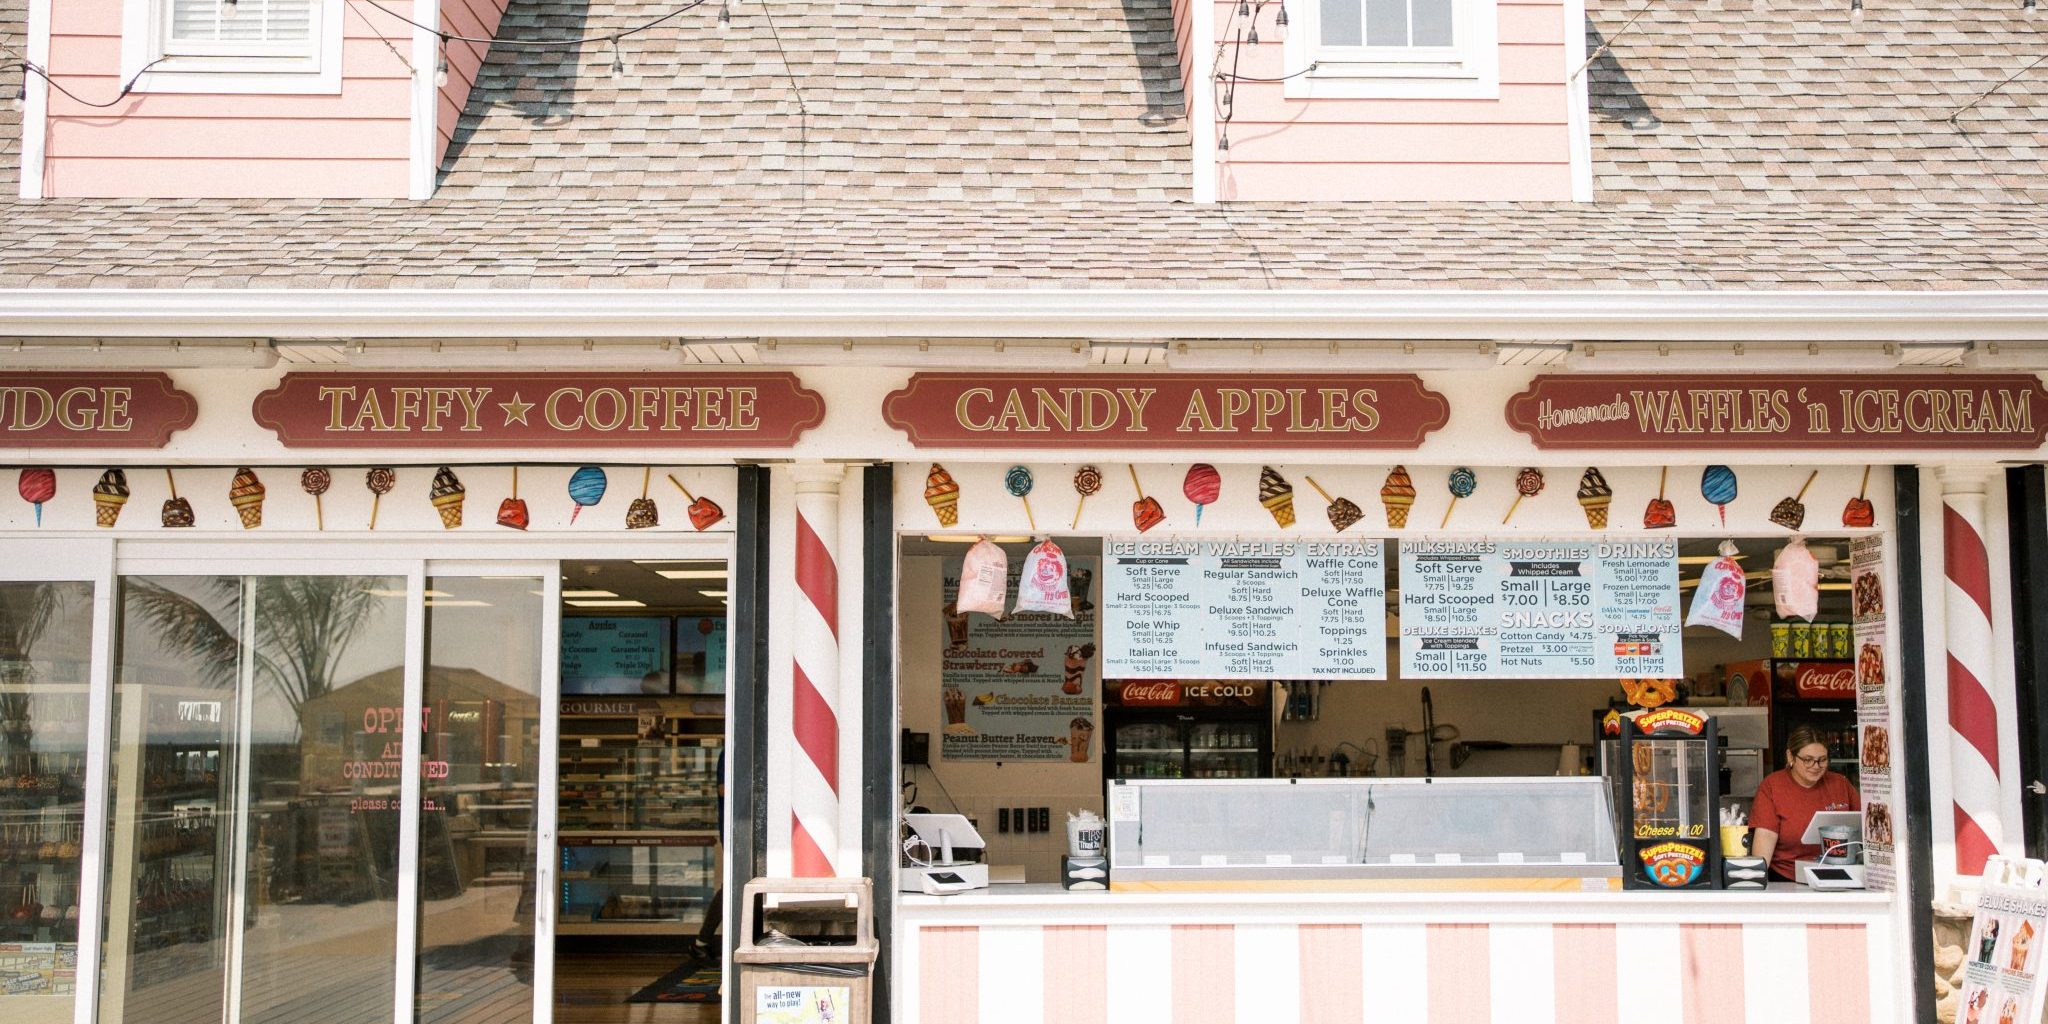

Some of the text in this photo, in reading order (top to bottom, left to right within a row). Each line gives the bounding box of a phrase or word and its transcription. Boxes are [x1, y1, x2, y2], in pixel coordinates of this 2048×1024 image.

[320, 386, 760, 432] TAFFY COFFEE
[955, 387, 1380, 433] CANDY APPLES
[1539, 394, 1630, 430] Homemade
[1631, 388, 1789, 434] WAFFLES
[1840, 389, 1900, 433] ICE
[1905, 389, 2034, 434] CREAM
[1108, 542, 1200, 556] ICE CREAM
[1207, 542, 1295, 556] WAFFLES
[1307, 543, 1378, 557] EXTRAS
[1402, 542, 1496, 554] MILKSHAKES
[1598, 543, 1675, 559] DRINKS
[1502, 548, 1589, 559] SMOOTHIES
[1306, 559, 1378, 568] Waffle Cone
[1415, 563, 1482, 573] Soft Serve
[1126, 567, 1180, 576] Soft Serve
[1204, 570, 1298, 580] Regular Sandwich
[1425, 583, 1473, 591] $7.75 $9.25
[1501, 580, 1591, 593] Small Large
[1301, 587, 1383, 597] Deluxe Waffle
[1117, 593, 1190, 603] Hard Scooped
[1328, 598, 1358, 607] Cone
[1405, 594, 1494, 606] Hard Scooped
[1502, 593, 1589, 606] $7.00 $8.50
[1209, 606, 1294, 614] Deluxe Sandwich
[1452, 607, 1477, 615] Large
[1424, 614, 1478, 622] $8.50 $10.50
[1500, 611, 1594, 628] SNACKS
[1127, 621, 1180, 631] Dole Whip
[1320, 626, 1367, 636] Toppings
[1403, 626, 1498, 636] DELUXE SHAKES
[1599, 624, 1679, 633] SODA FLOATS
[1500, 632, 1593, 641] Cotton Candy $4.75
[1205, 642, 1298, 651] Infused Sandwich
[1500, 645, 1533, 653] Pretzel
[1542, 645, 1568, 653] $3.00
[943, 648, 1044, 659] Chocolate Covered
[1129, 648, 1178, 657] Italian Ice
[1319, 648, 1368, 658] Sprinkles
[1415, 652, 1487, 662] Small Large
[943, 660, 1004, 672] Strawberry
[1501, 658, 1595, 666] Hot Nuts $5.50
[1413, 663, 1487, 672] $10.00 $11.50
[1123, 682, 1254, 700] Coca-Cola ICE COLD
[996, 694, 1093, 705] Chocolate Banana
[560, 703, 635, 713] GOURMET
[943, 734, 1055, 744] Peanut Butter Heaven
[351, 796, 387, 814] please
[1081, 830, 1101, 841] TIPS
[1638, 824, 1704, 837] Cheese $1.00
[1977, 895, 2047, 917] DELUXE SHAKES
[773, 990, 801, 1000] all-new
